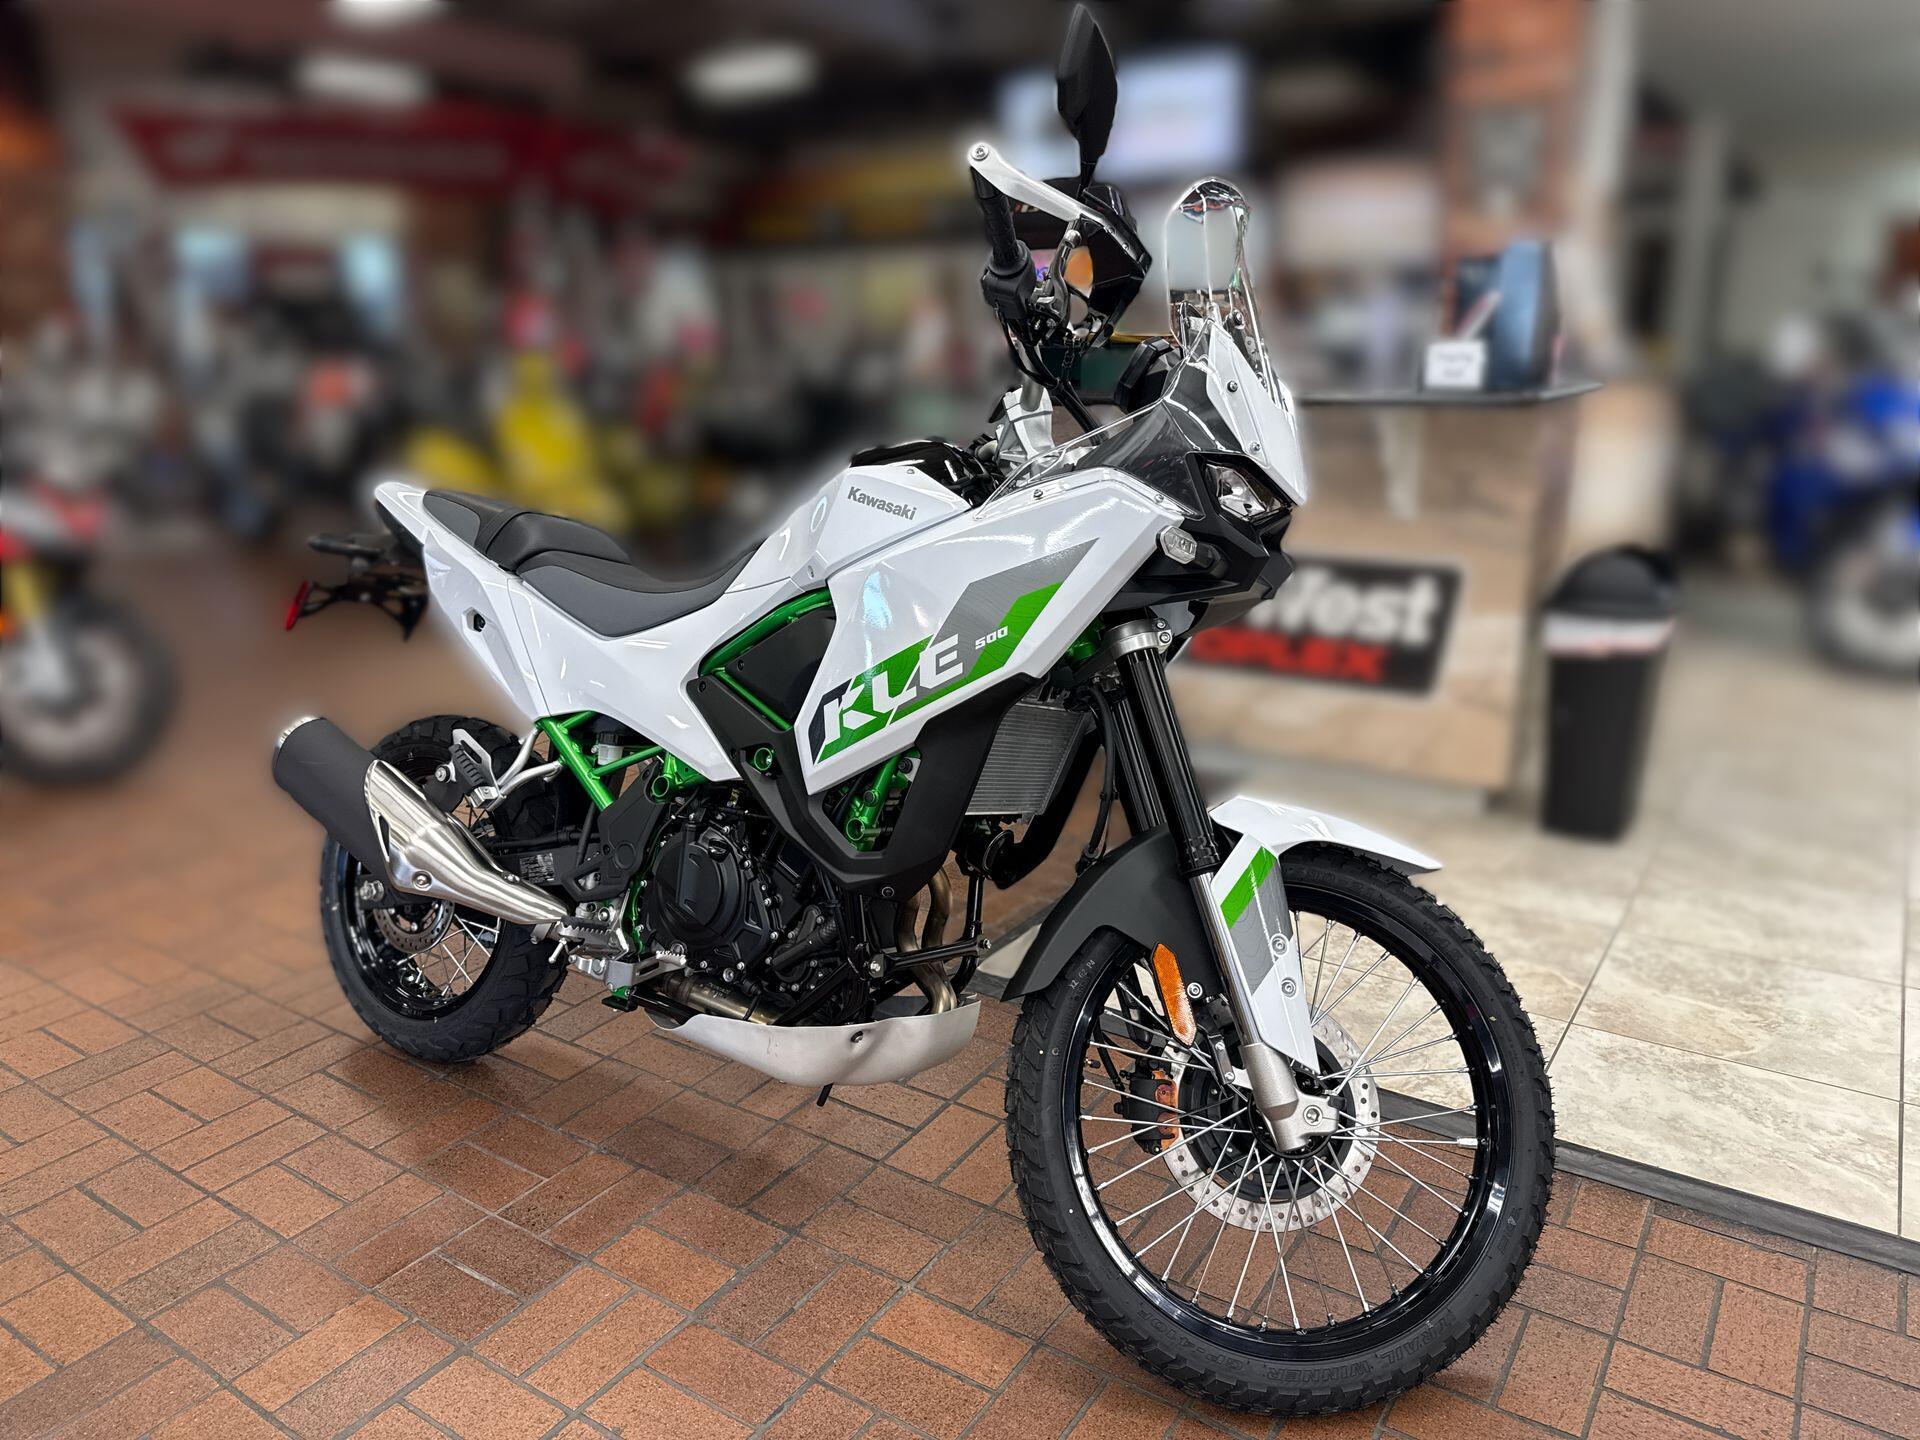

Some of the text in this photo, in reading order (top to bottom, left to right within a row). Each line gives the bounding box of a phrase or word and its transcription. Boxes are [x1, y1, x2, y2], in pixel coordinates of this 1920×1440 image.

[847, 486, 917, 520] Kawasaki
[824, 626, 1008, 746] KLE 500
[1265, 1361, 1374, 1384] WINNER
